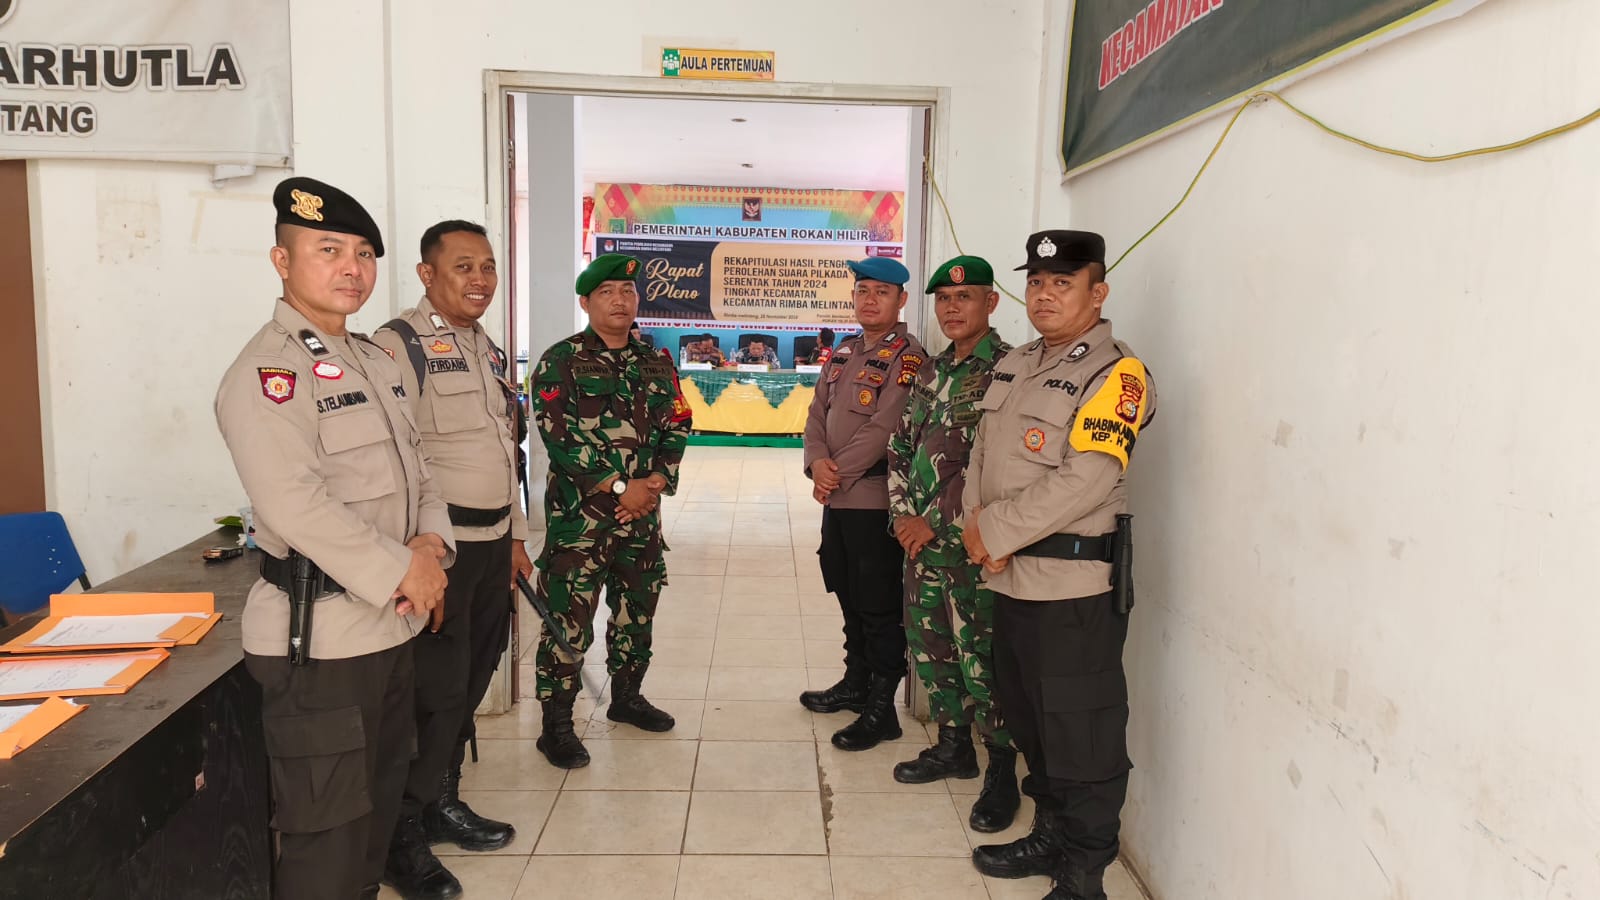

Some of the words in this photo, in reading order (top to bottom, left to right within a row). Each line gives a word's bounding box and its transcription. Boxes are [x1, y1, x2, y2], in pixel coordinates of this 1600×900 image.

[1098, 0, 1224, 90] KECAMAT
[681, 56, 708, 70] AULA
[711, 57, 772, 72] PERTEMUAN
[0, 105, 94, 132] TANG
[634, 224, 711, 236] PEMERINTAH
[716, 227, 787, 238] KABUPATEN
[791, 229, 833, 240] ROKAN
[837, 231, 869, 240] HILIR
[646, 258, 704, 282] Rapat
[724, 257, 787, 267] REKAPITULASI
[790, 259, 815, 267] HASIL
[724, 267, 776, 277] PEROLEHAN
[779, 268, 808, 278] SUARA
[811, 269, 848, 279] PILKADA
[646, 280, 699, 301] Pleno
[723, 277, 769, 287] SERENTAK
[772, 278, 801, 288] TAHUN
[803, 280, 827, 288] 2024
[724, 287, 760, 297] TINGKAT
[763, 289, 816, 298] KECAMATAN
[723, 298, 777, 308] KECAMATAN
[780, 300, 808, 309] RIMBA
[1043, 379, 1078, 396] POLRI
[1091, 432, 1112, 443] KEP.
